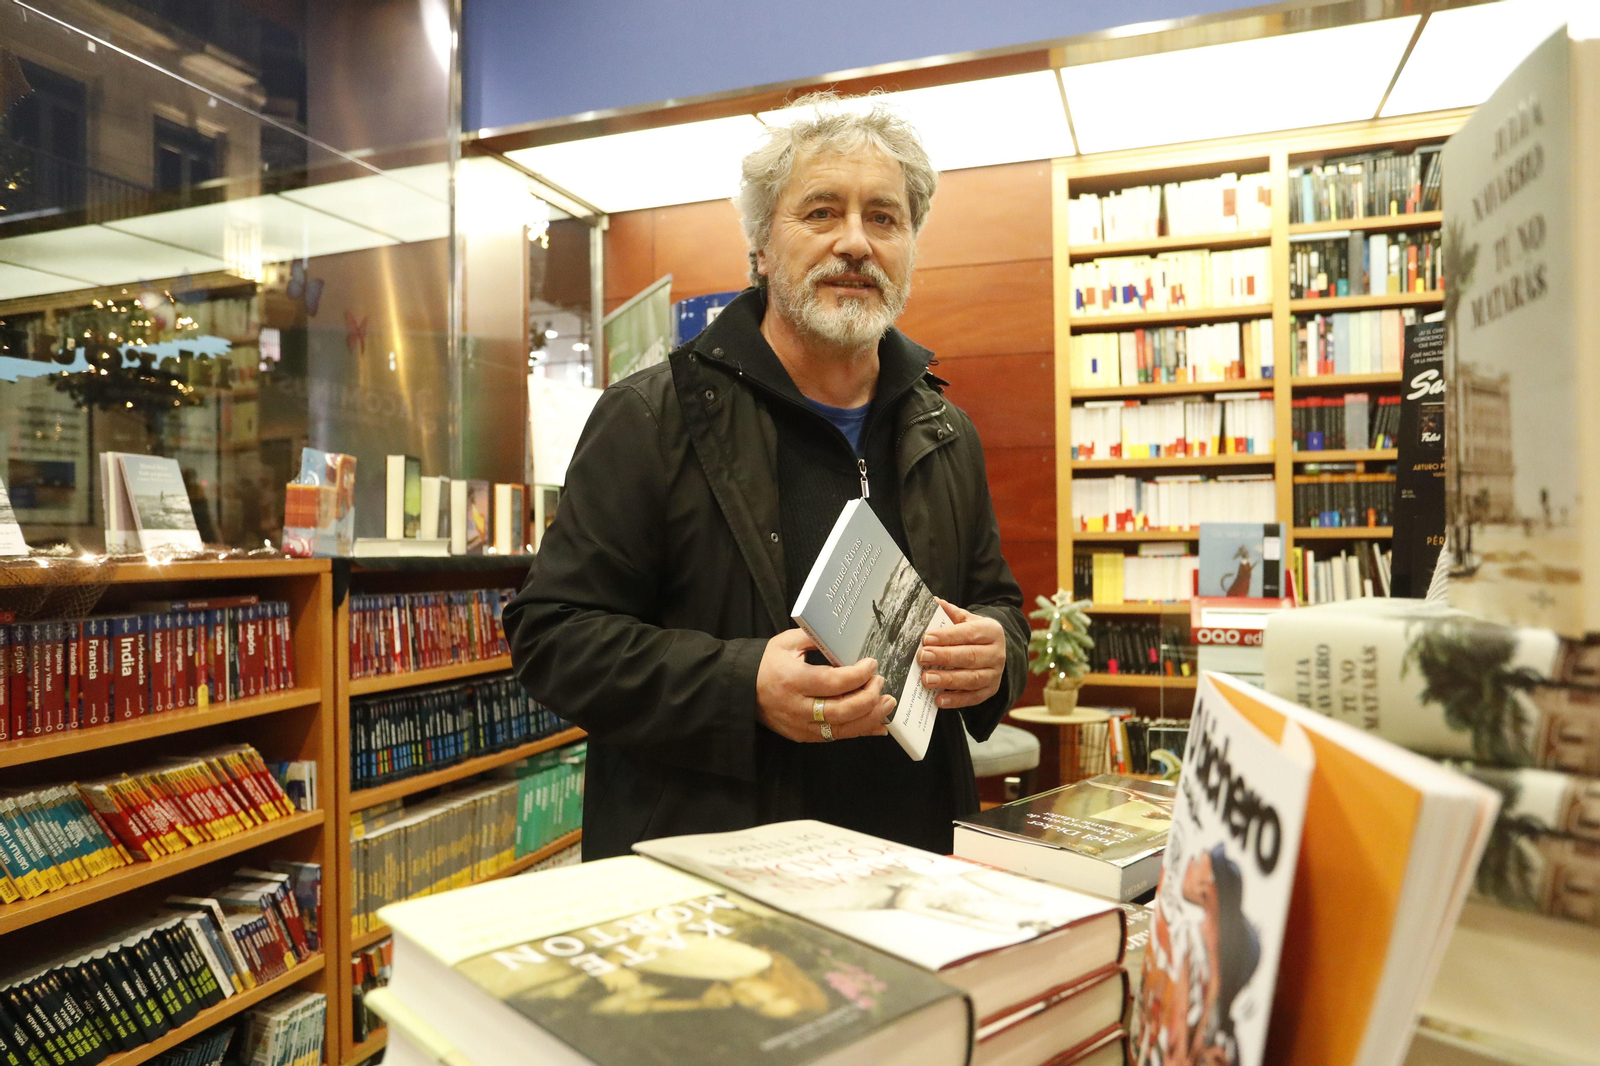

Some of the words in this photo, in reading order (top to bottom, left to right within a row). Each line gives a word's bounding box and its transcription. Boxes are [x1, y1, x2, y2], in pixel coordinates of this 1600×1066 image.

[1413, 463, 1439, 471] ARTURO
[826, 562, 847, 602] Manuel
[844, 538, 861, 565] Rivas
[832, 595, 847, 617] Vivir
[845, 579, 856, 595] sen
[851, 544, 877, 582] permiso
[840, 605, 852, 629] outras
[850, 576, 869, 606] historias
[863, 565, 873, 576] de
[869, 546, 884, 566] Oeste
[186, 628, 194, 656] Islandia
[215, 626, 223, 655] Irlanda
[246, 623, 257, 655] Japón
[1197, 629, 1240, 644] OQO
[121, 637, 135, 676] India
[153, 633, 163, 663] Irlanda
[14, 646, 25, 673] Egipto
[55, 644, 63, 674] Filipinas
[69, 642, 78, 675] Finlandia
[88, 639, 99, 680] Francia
[137, 635, 146, 685] Indonesia
[176, 647, 184, 671] griegas
[132, 813, 147, 833] BURGOS
[1042, 812, 1080, 823] Mailer
[1042, 817, 1111, 836] desaparición
[129, 818, 142, 836] ÁVILA
[1027, 820, 1081, 837] Dicker
[1080, 820, 1138, 838] Stephanie
[24, 827, 44, 858] EXTREMADURA
[1081, 833, 1120, 847] Joël
[1113, 834, 1129, 842] La
[9, 842, 29, 870] CASTILLA
[723, 842, 907, 882] POSADAS
[490, 894, 739, 972] MORTON
[567, 918, 735, 978] KATE
[148, 968, 158, 984] PALMA
[163, 956, 178, 980] PIRINEOS
[104, 982, 120, 1006] MALLORCA
[122, 981, 135, 1000] MADRID
[167, 988, 175, 999] AZUL
[177, 980, 185, 992] AZUL
[64, 998, 76, 1015] RIOJA
[97, 991, 110, 1011] MÁLAGA
[135, 1002, 144, 1014] AZUL
[146, 999, 155, 1011] AZUL
[34, 1004, 48, 1022] CANARIA
[53, 1012, 66, 1030] HUELVA
[60, 1008, 73, 1026] HUESCA
[74, 1013, 81, 1022] LA
[110, 1013, 120, 1025] AZUL
[120, 1009, 129, 1021] AZUL
[26, 1013, 45, 1038] GRANADA
[45, 1021, 56, 1033] GRAN
[73, 1028, 83, 1040] AZUL
[83, 1026, 92, 1037] AZUL
[14, 1031, 25, 1046] SORIA
[45, 1040, 56, 1052] AZUL
[56, 1035, 67, 1048] AZUL
[66, 1032, 77, 1044] AZUL
[7, 1052, 19, 1065] AZUL
